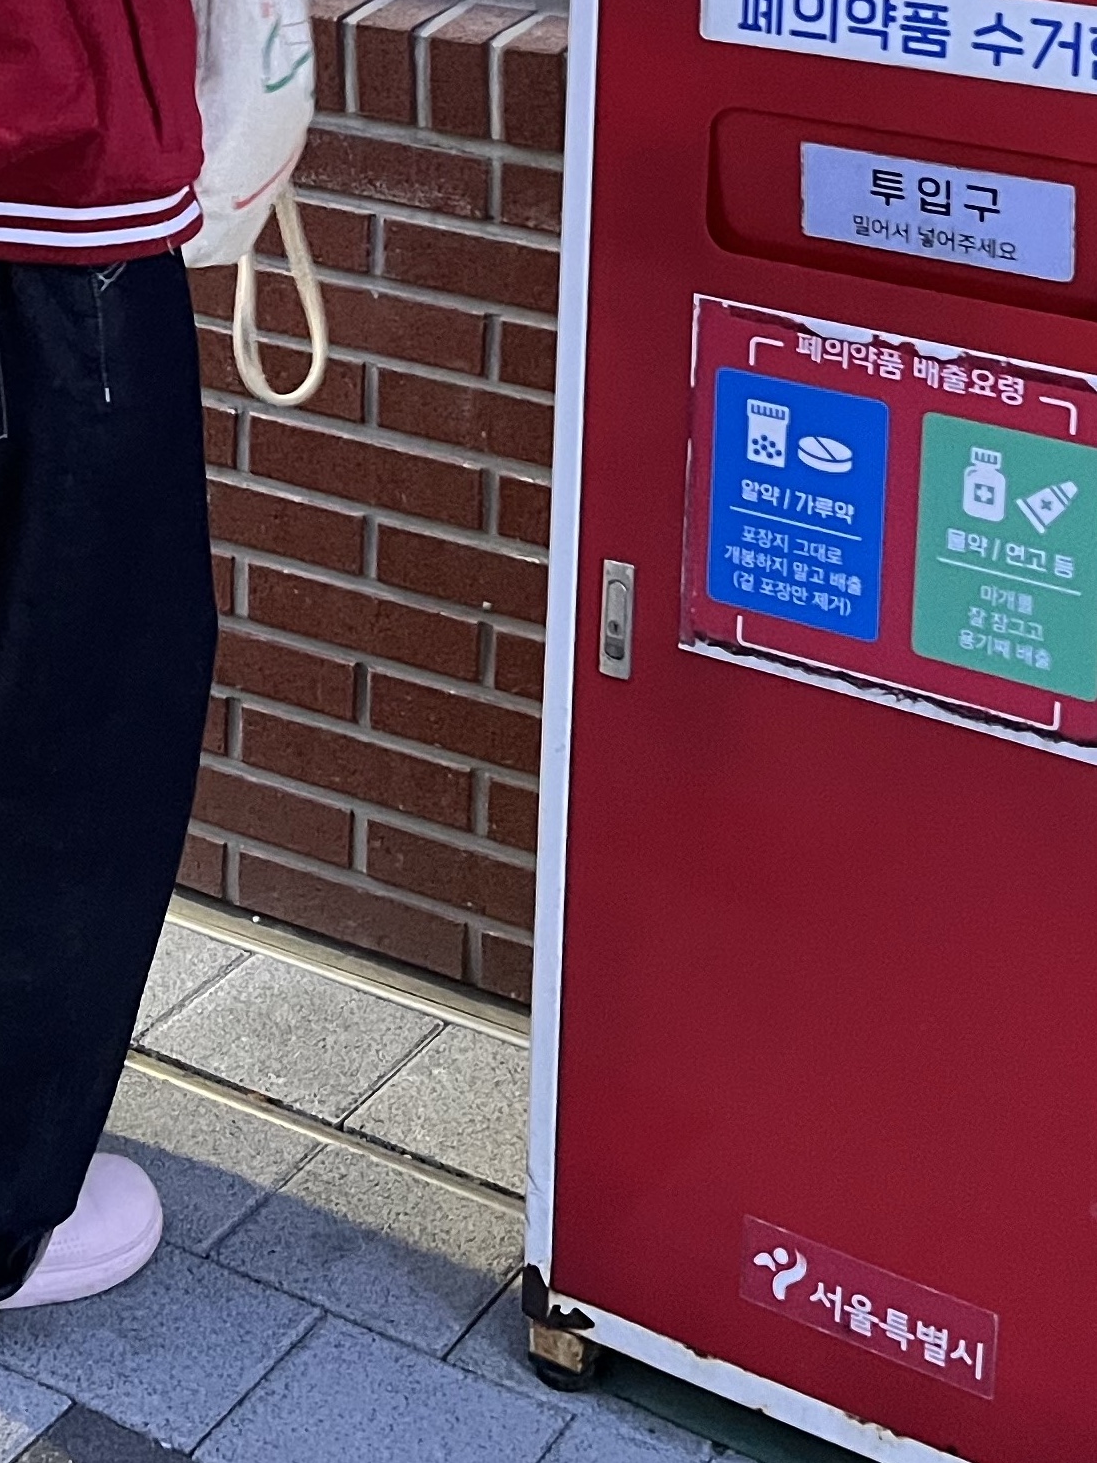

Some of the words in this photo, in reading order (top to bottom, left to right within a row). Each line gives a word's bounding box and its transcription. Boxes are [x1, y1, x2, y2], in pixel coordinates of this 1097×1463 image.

[852, 214, 910, 244] 밀어서
[917, 225, 1019, 261] 넣어주세요
[795, 331, 905, 381] 폐의약품
[912, 356, 1025, 407] 배출요령
[740, 478, 781, 507] 알약
[794, 490, 855, 525] 가루약
[740, 524, 790, 554] 포장지
[792, 537, 844, 566] 그대로
[1005, 542, 1048, 573] 연고
[1053, 553, 1075, 579] 등
[723, 544, 789, 578] 개봉하지
[792, 561, 826, 585] 말고
[828, 571, 863, 597] 배출
[758, 576, 809, 606] 포장만
[811, 591, 852, 617] 제거)
[809, 1280, 986, 1382] 서울특별시
